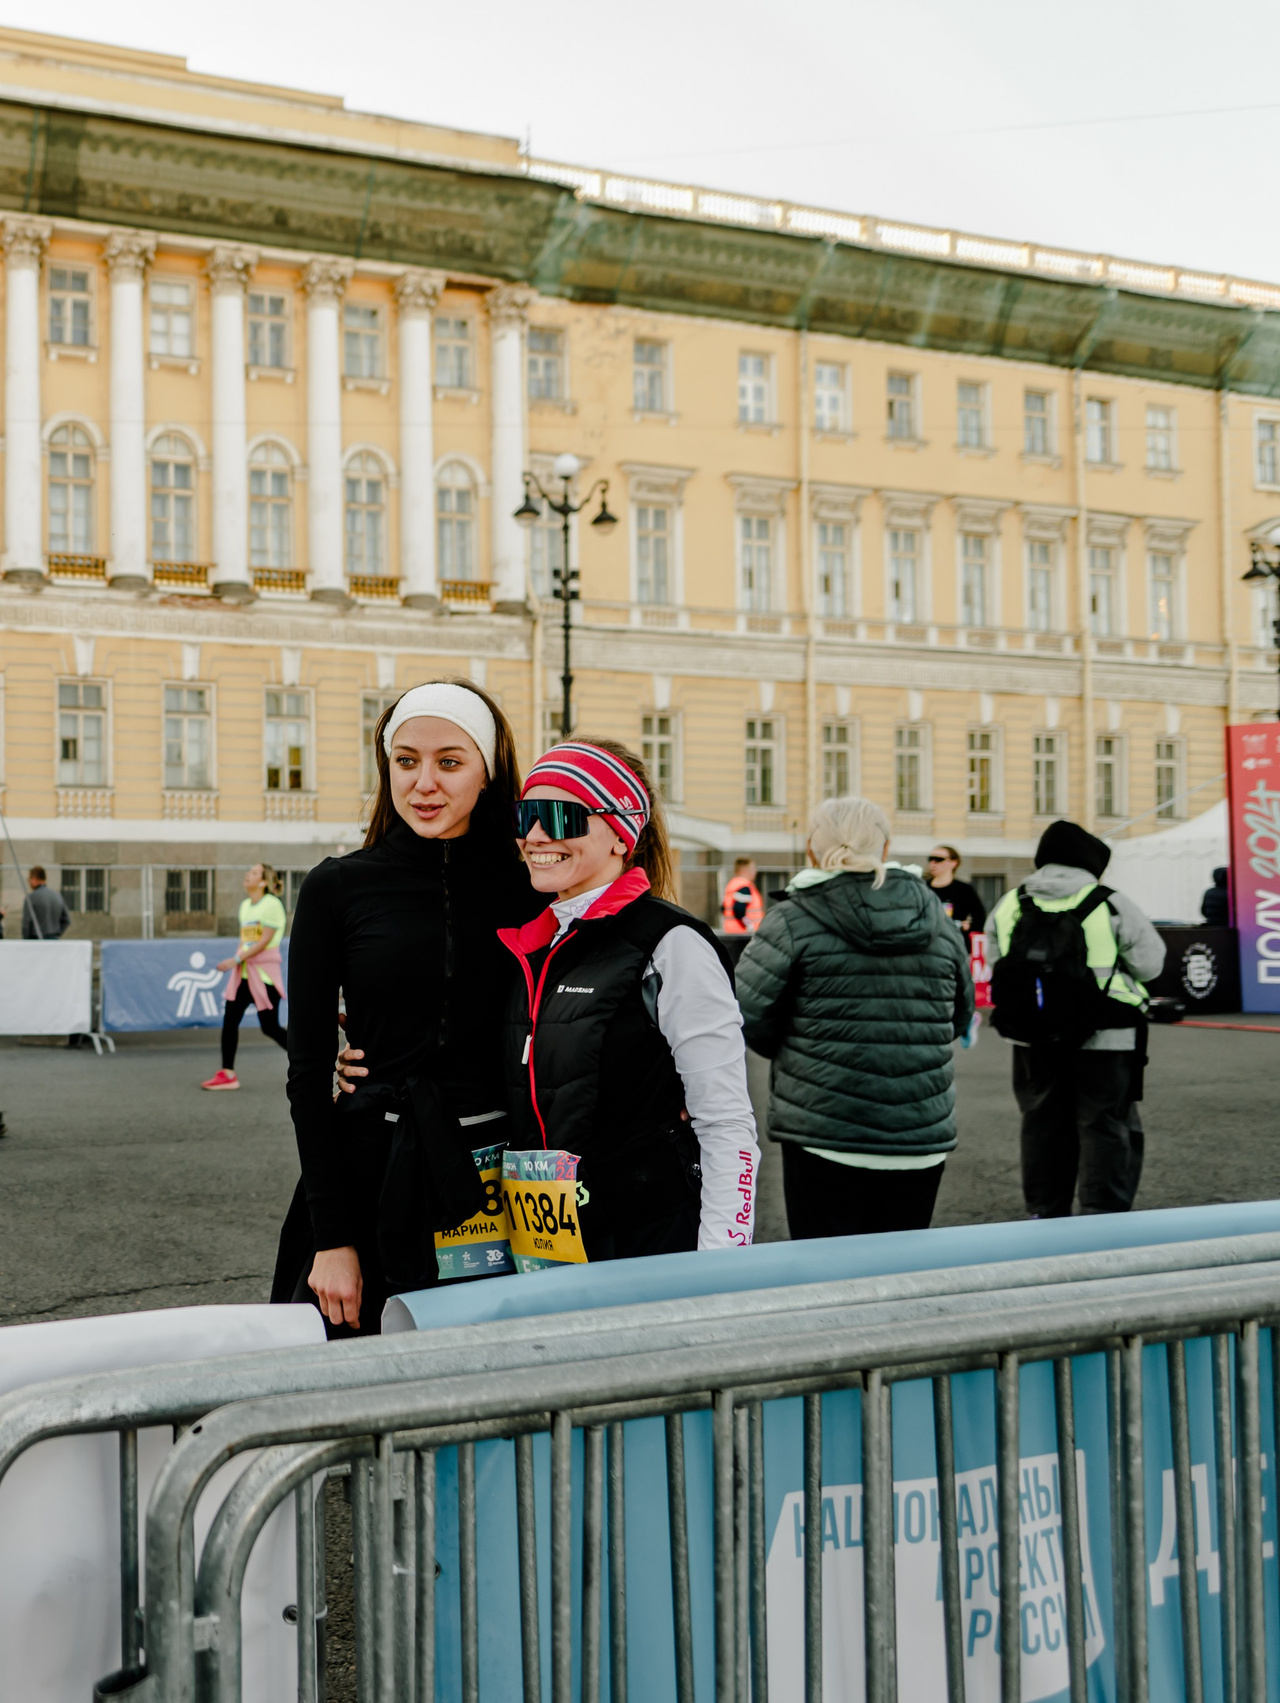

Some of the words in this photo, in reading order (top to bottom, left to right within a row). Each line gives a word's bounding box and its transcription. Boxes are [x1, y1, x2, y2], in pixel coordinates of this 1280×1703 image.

[523, 1160, 533, 1171] 10
[555, 1166, 575, 1181] 24
[503, 1190, 577, 1236] 11384
[441, 1221, 498, 1239] МАРИНА
[533, 1237, 554, 1251] ЮЛИЯ
